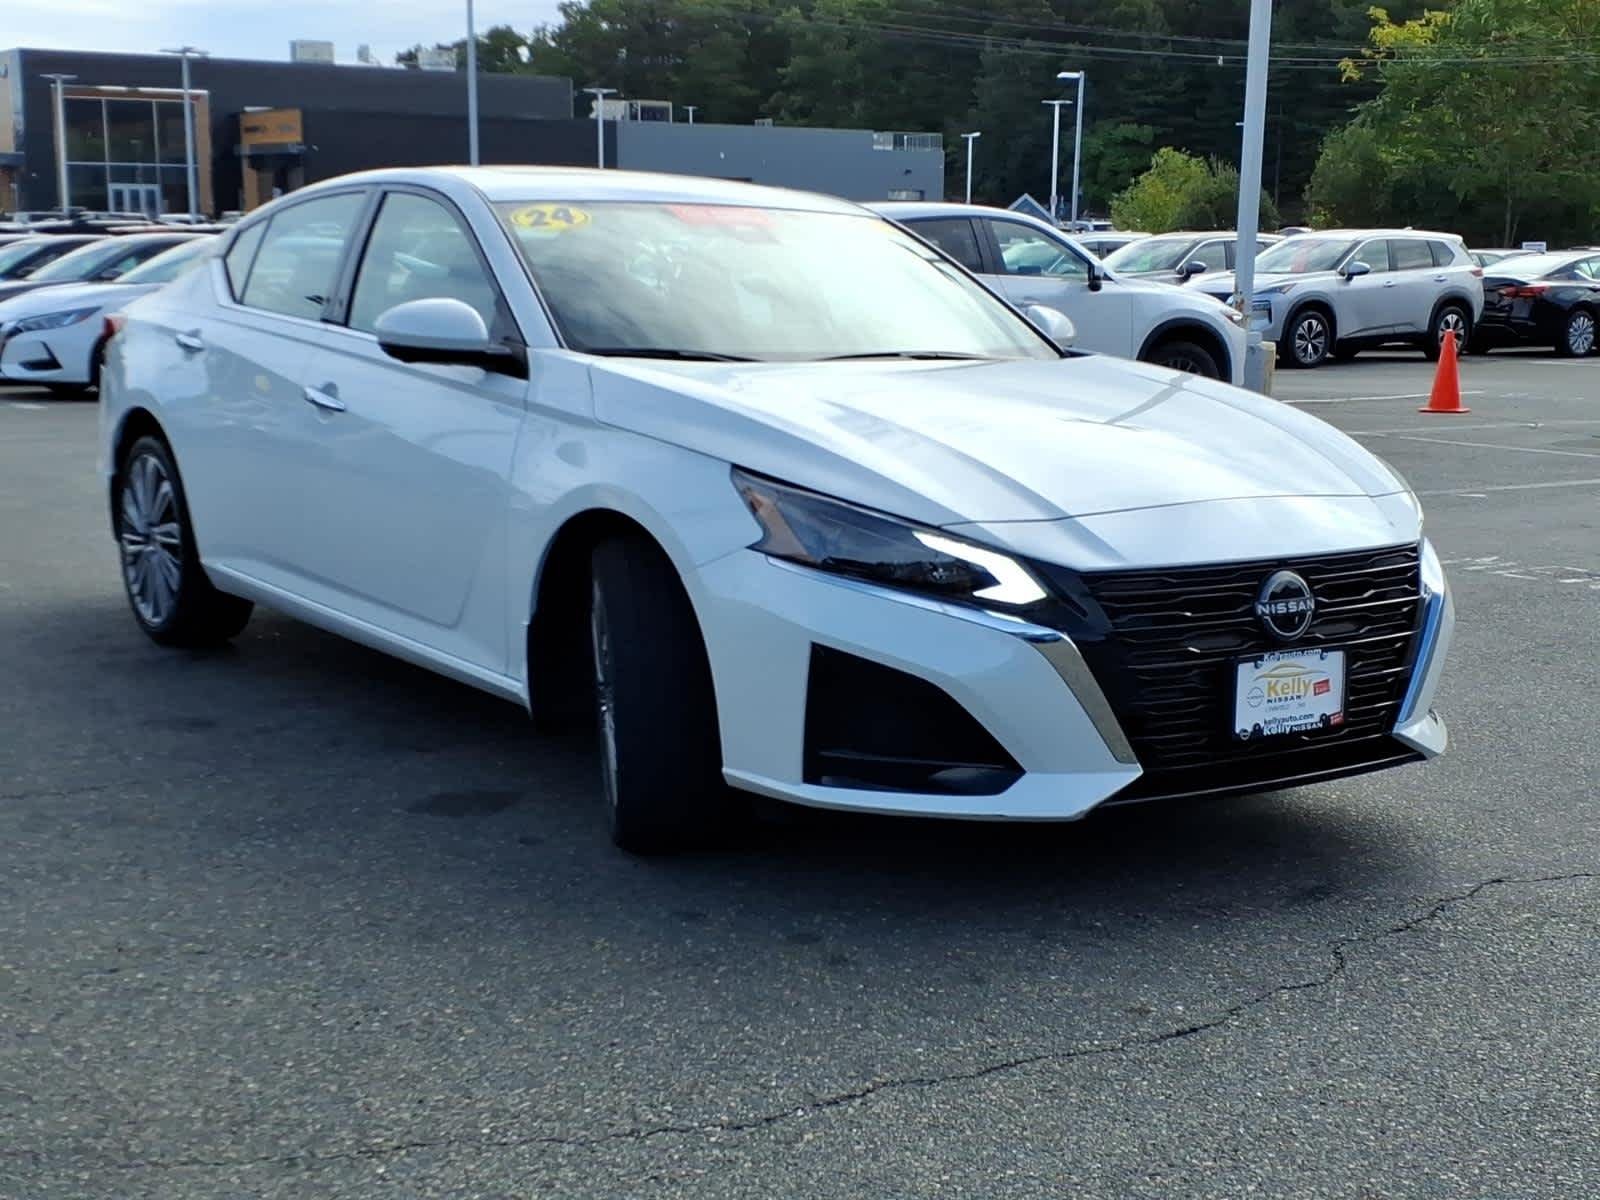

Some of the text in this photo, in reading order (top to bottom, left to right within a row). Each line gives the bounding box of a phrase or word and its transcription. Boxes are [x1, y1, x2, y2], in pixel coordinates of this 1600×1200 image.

[525, 207, 574, 226] 24
[1257, 600, 1314, 614] NISSAN
[1266, 678, 1312, 697] Kelly
[1266, 695, 1302, 704] NISSAN
